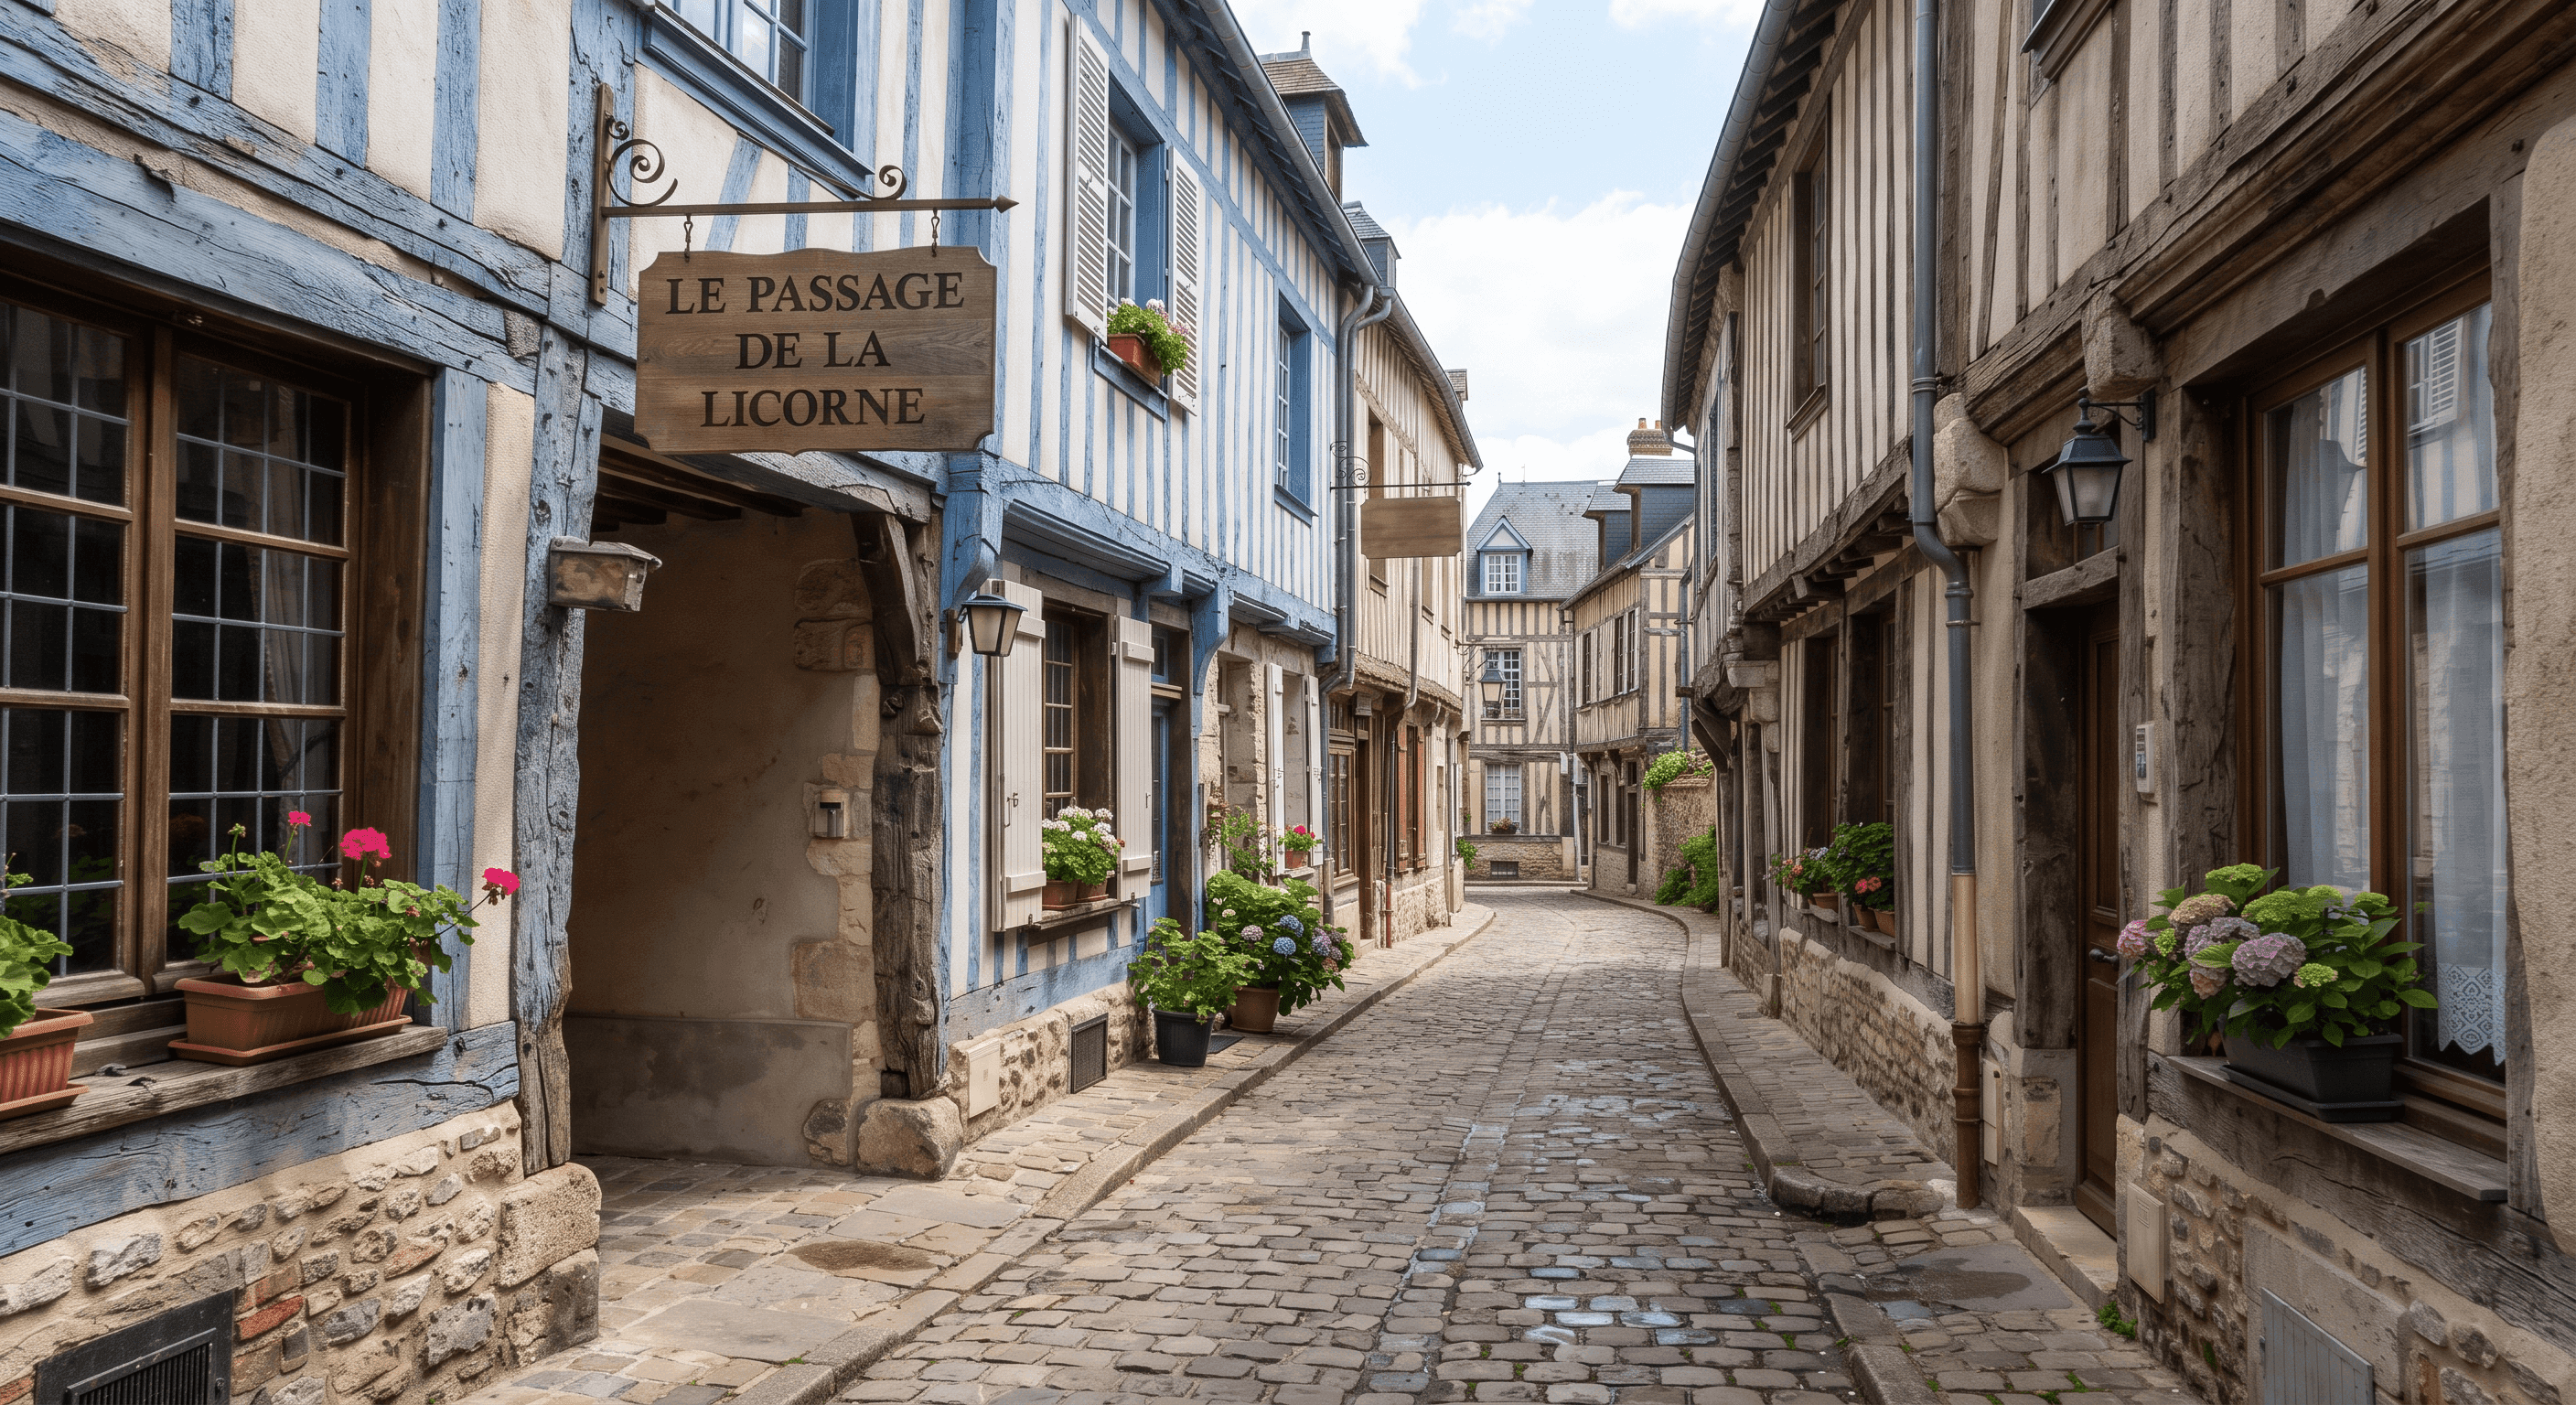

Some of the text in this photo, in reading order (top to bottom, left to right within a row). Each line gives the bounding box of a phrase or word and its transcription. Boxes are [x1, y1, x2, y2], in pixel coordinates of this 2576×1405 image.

[665, 272, 964, 315] LE PASSAGE
[735, 330, 891, 370] DE LA
[700, 388, 926, 427] LICORNE
